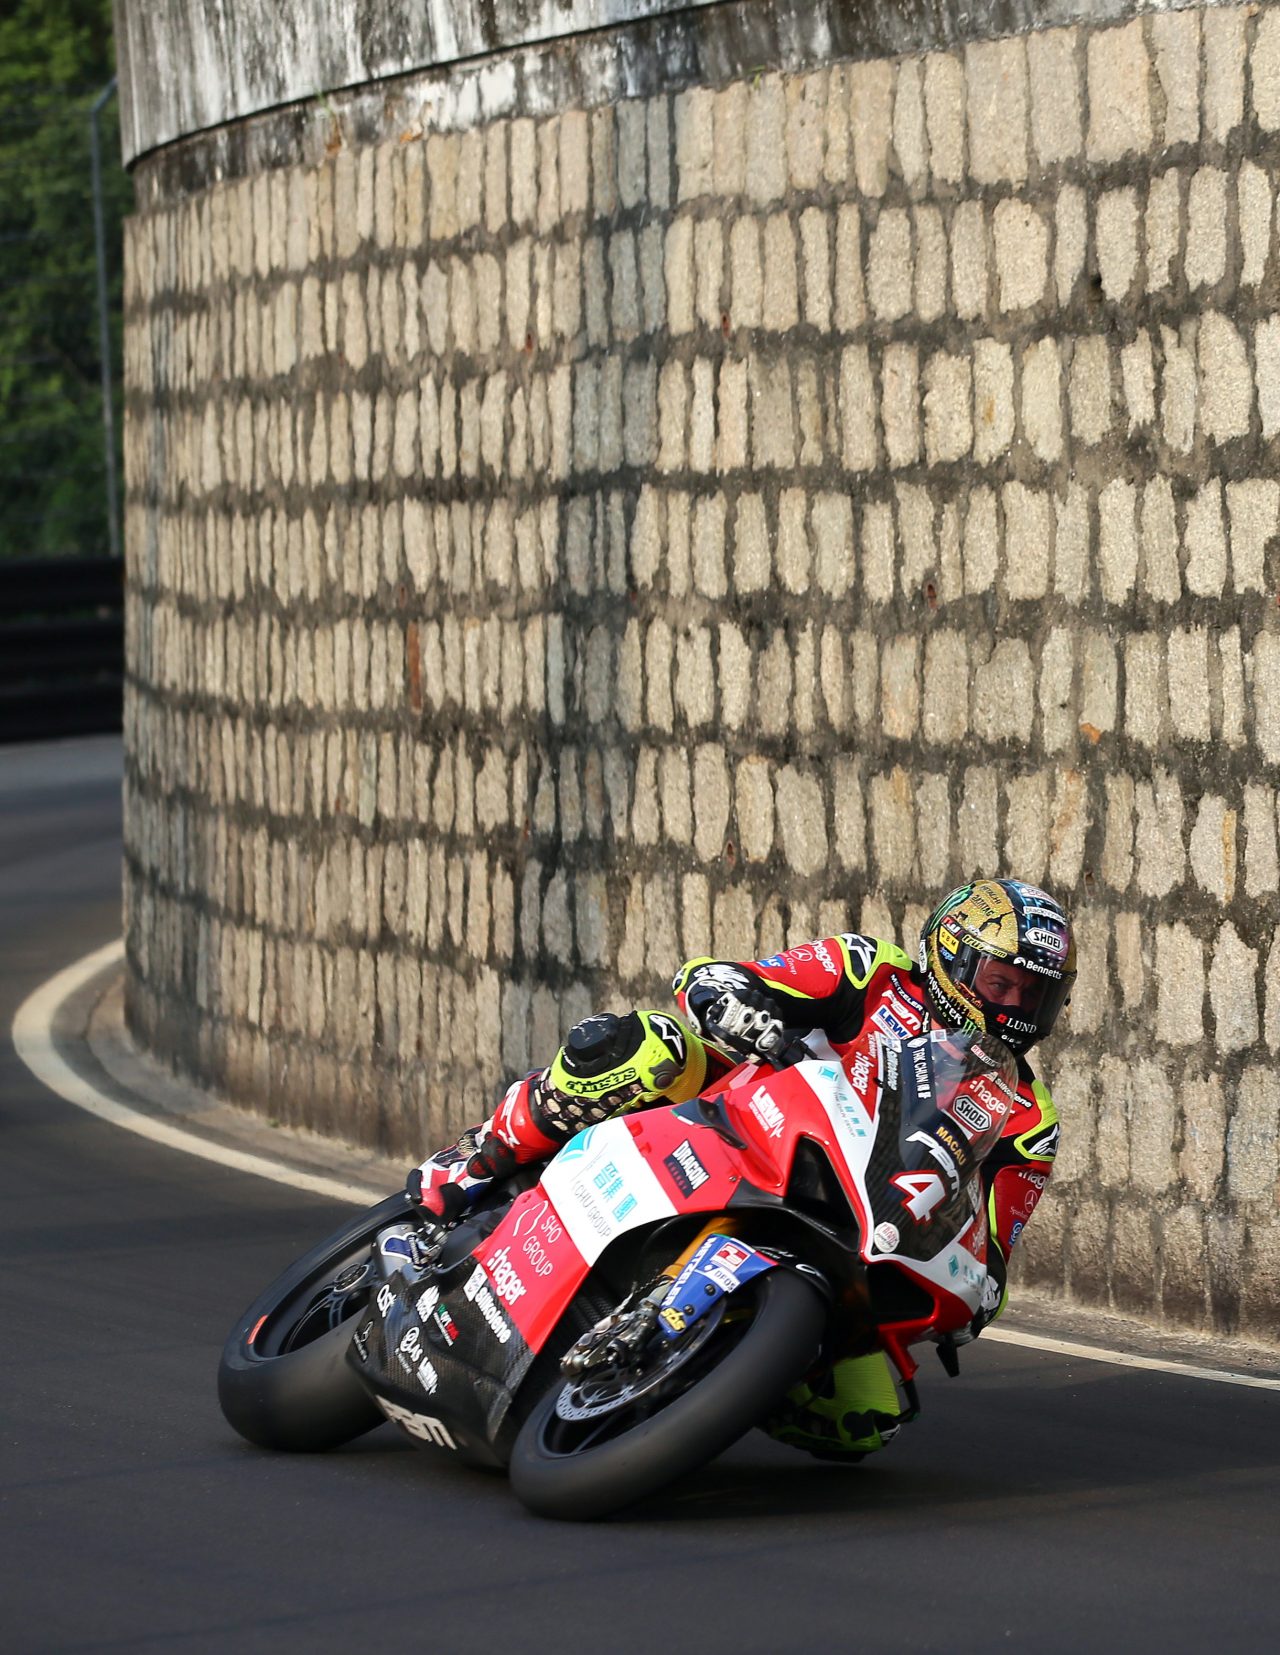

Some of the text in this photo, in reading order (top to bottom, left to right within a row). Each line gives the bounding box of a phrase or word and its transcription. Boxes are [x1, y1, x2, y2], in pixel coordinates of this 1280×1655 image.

[1033, 931, 1060, 949] SHOEI
[1026, 960, 1063, 980] Bennetts
[890, 973, 924, 1011] METZELER
[879, 1007, 908, 1038] LEW
[1006, 1017, 1037, 1034] LUND
[565, 1067, 638, 1094] alpinestars
[956, 1100, 986, 1127] SHOEI
[935, 1125, 967, 1166] MACAU
[671, 1139, 710, 1190] DRAGON
[893, 1172, 946, 1222] 4
[541, 1214, 562, 1244] SHO
[586, 1205, 612, 1237] GROUP
[523, 1235, 554, 1277] GROUP
[660, 1236, 718, 1307] METZELER
